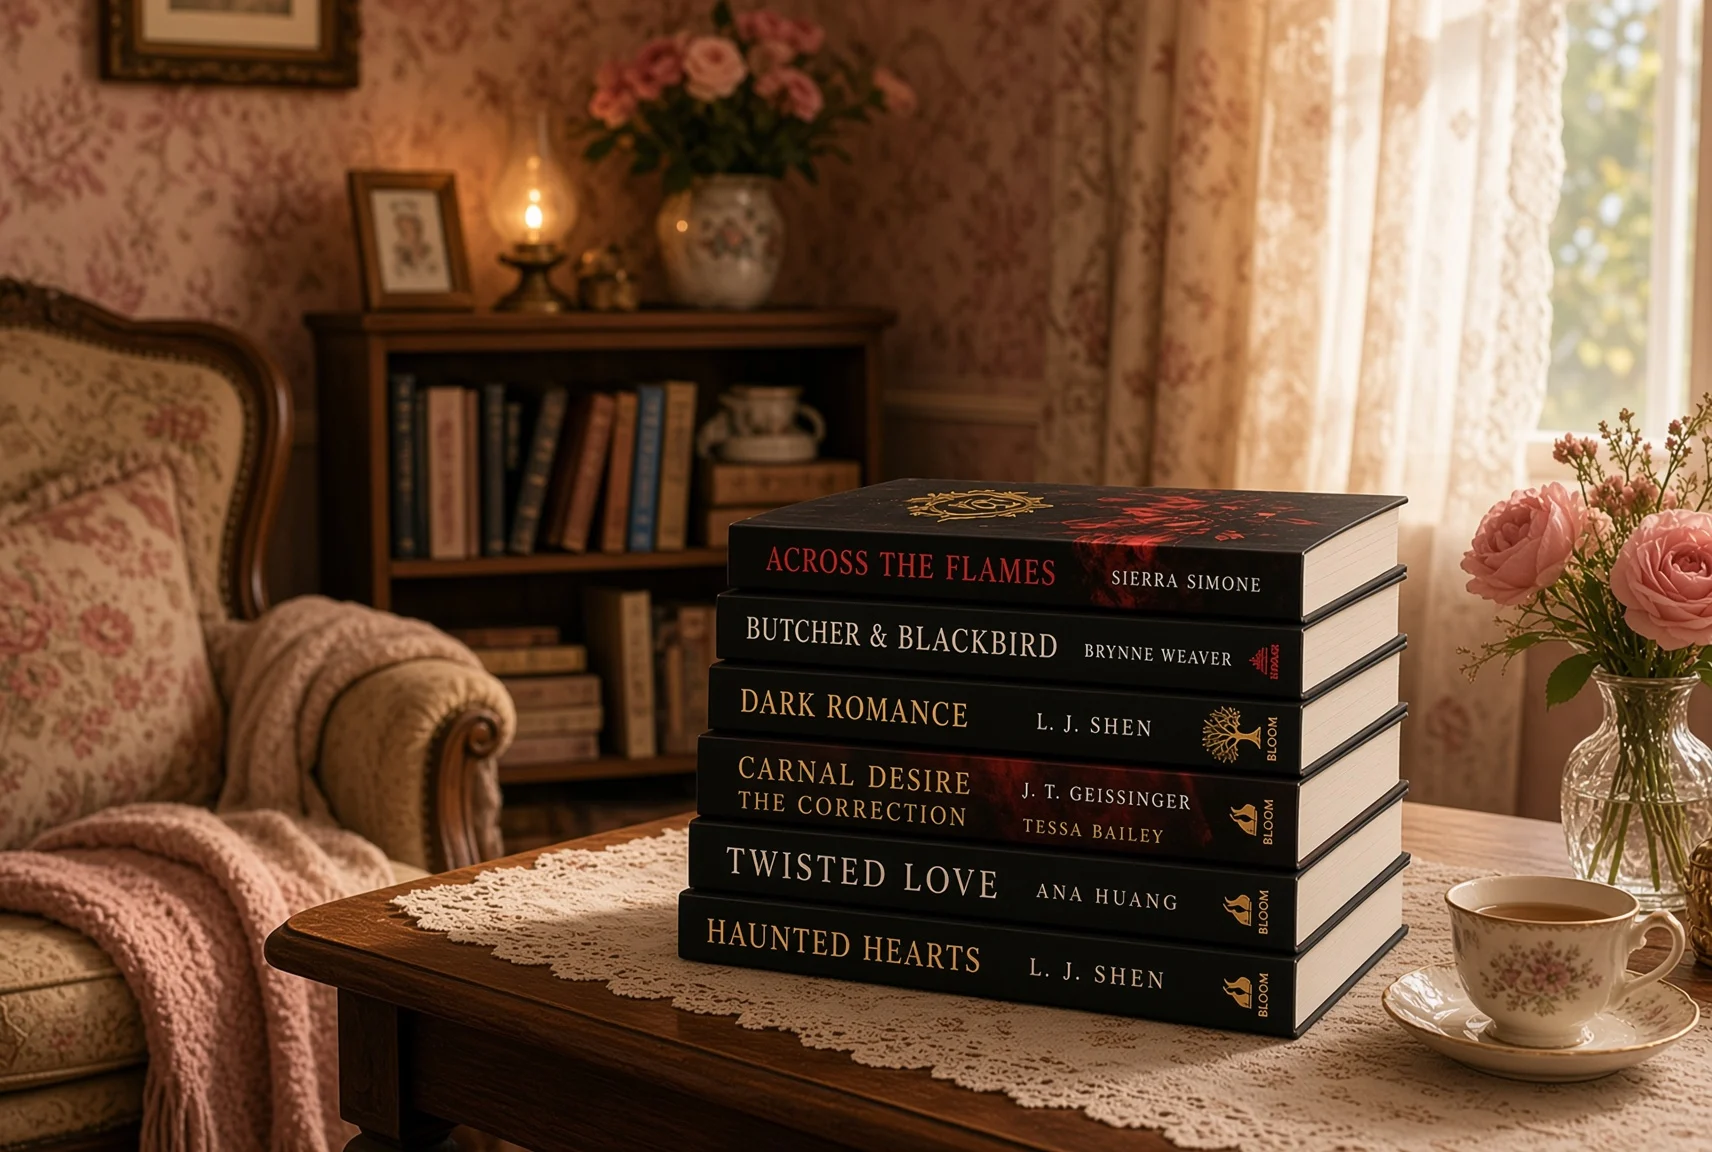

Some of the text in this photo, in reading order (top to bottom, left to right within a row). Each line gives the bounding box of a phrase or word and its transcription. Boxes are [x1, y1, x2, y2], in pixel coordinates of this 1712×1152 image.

[767, 547, 1055, 585] ACROSS THE FLAMES
[1112, 570, 1260, 592] SIERRA SIMONE
[747, 616, 1057, 658] BUTCHER & BLACKBIRD
[1085, 644, 1231, 666] BRYNNE WEAVER
[741, 689, 967, 727] DARK ROMANCE
[1037, 713, 1151, 736] L. J. SHEN
[1267, 717, 1277, 761] BLOOM
[739, 756, 970, 794] CARNAL DESIRE
[738, 791, 966, 827] THE CORRECTION
[1022, 783, 1190, 810] J. T. GEISSINGER
[1023, 819, 1163, 843] TESSA BAILEY
[1263, 800, 1273, 845] BLOOM
[727, 847, 997, 898] TWISTED LOVE
[1036, 884, 1176, 910] ANA HUANG
[1259, 890, 1268, 934] BLOOM
[707, 918, 979, 972] HAUNTED HEARTS
[1030, 958, 1163, 989] L. J. SHEN
[1258, 973, 1268, 1017] BLOOM
